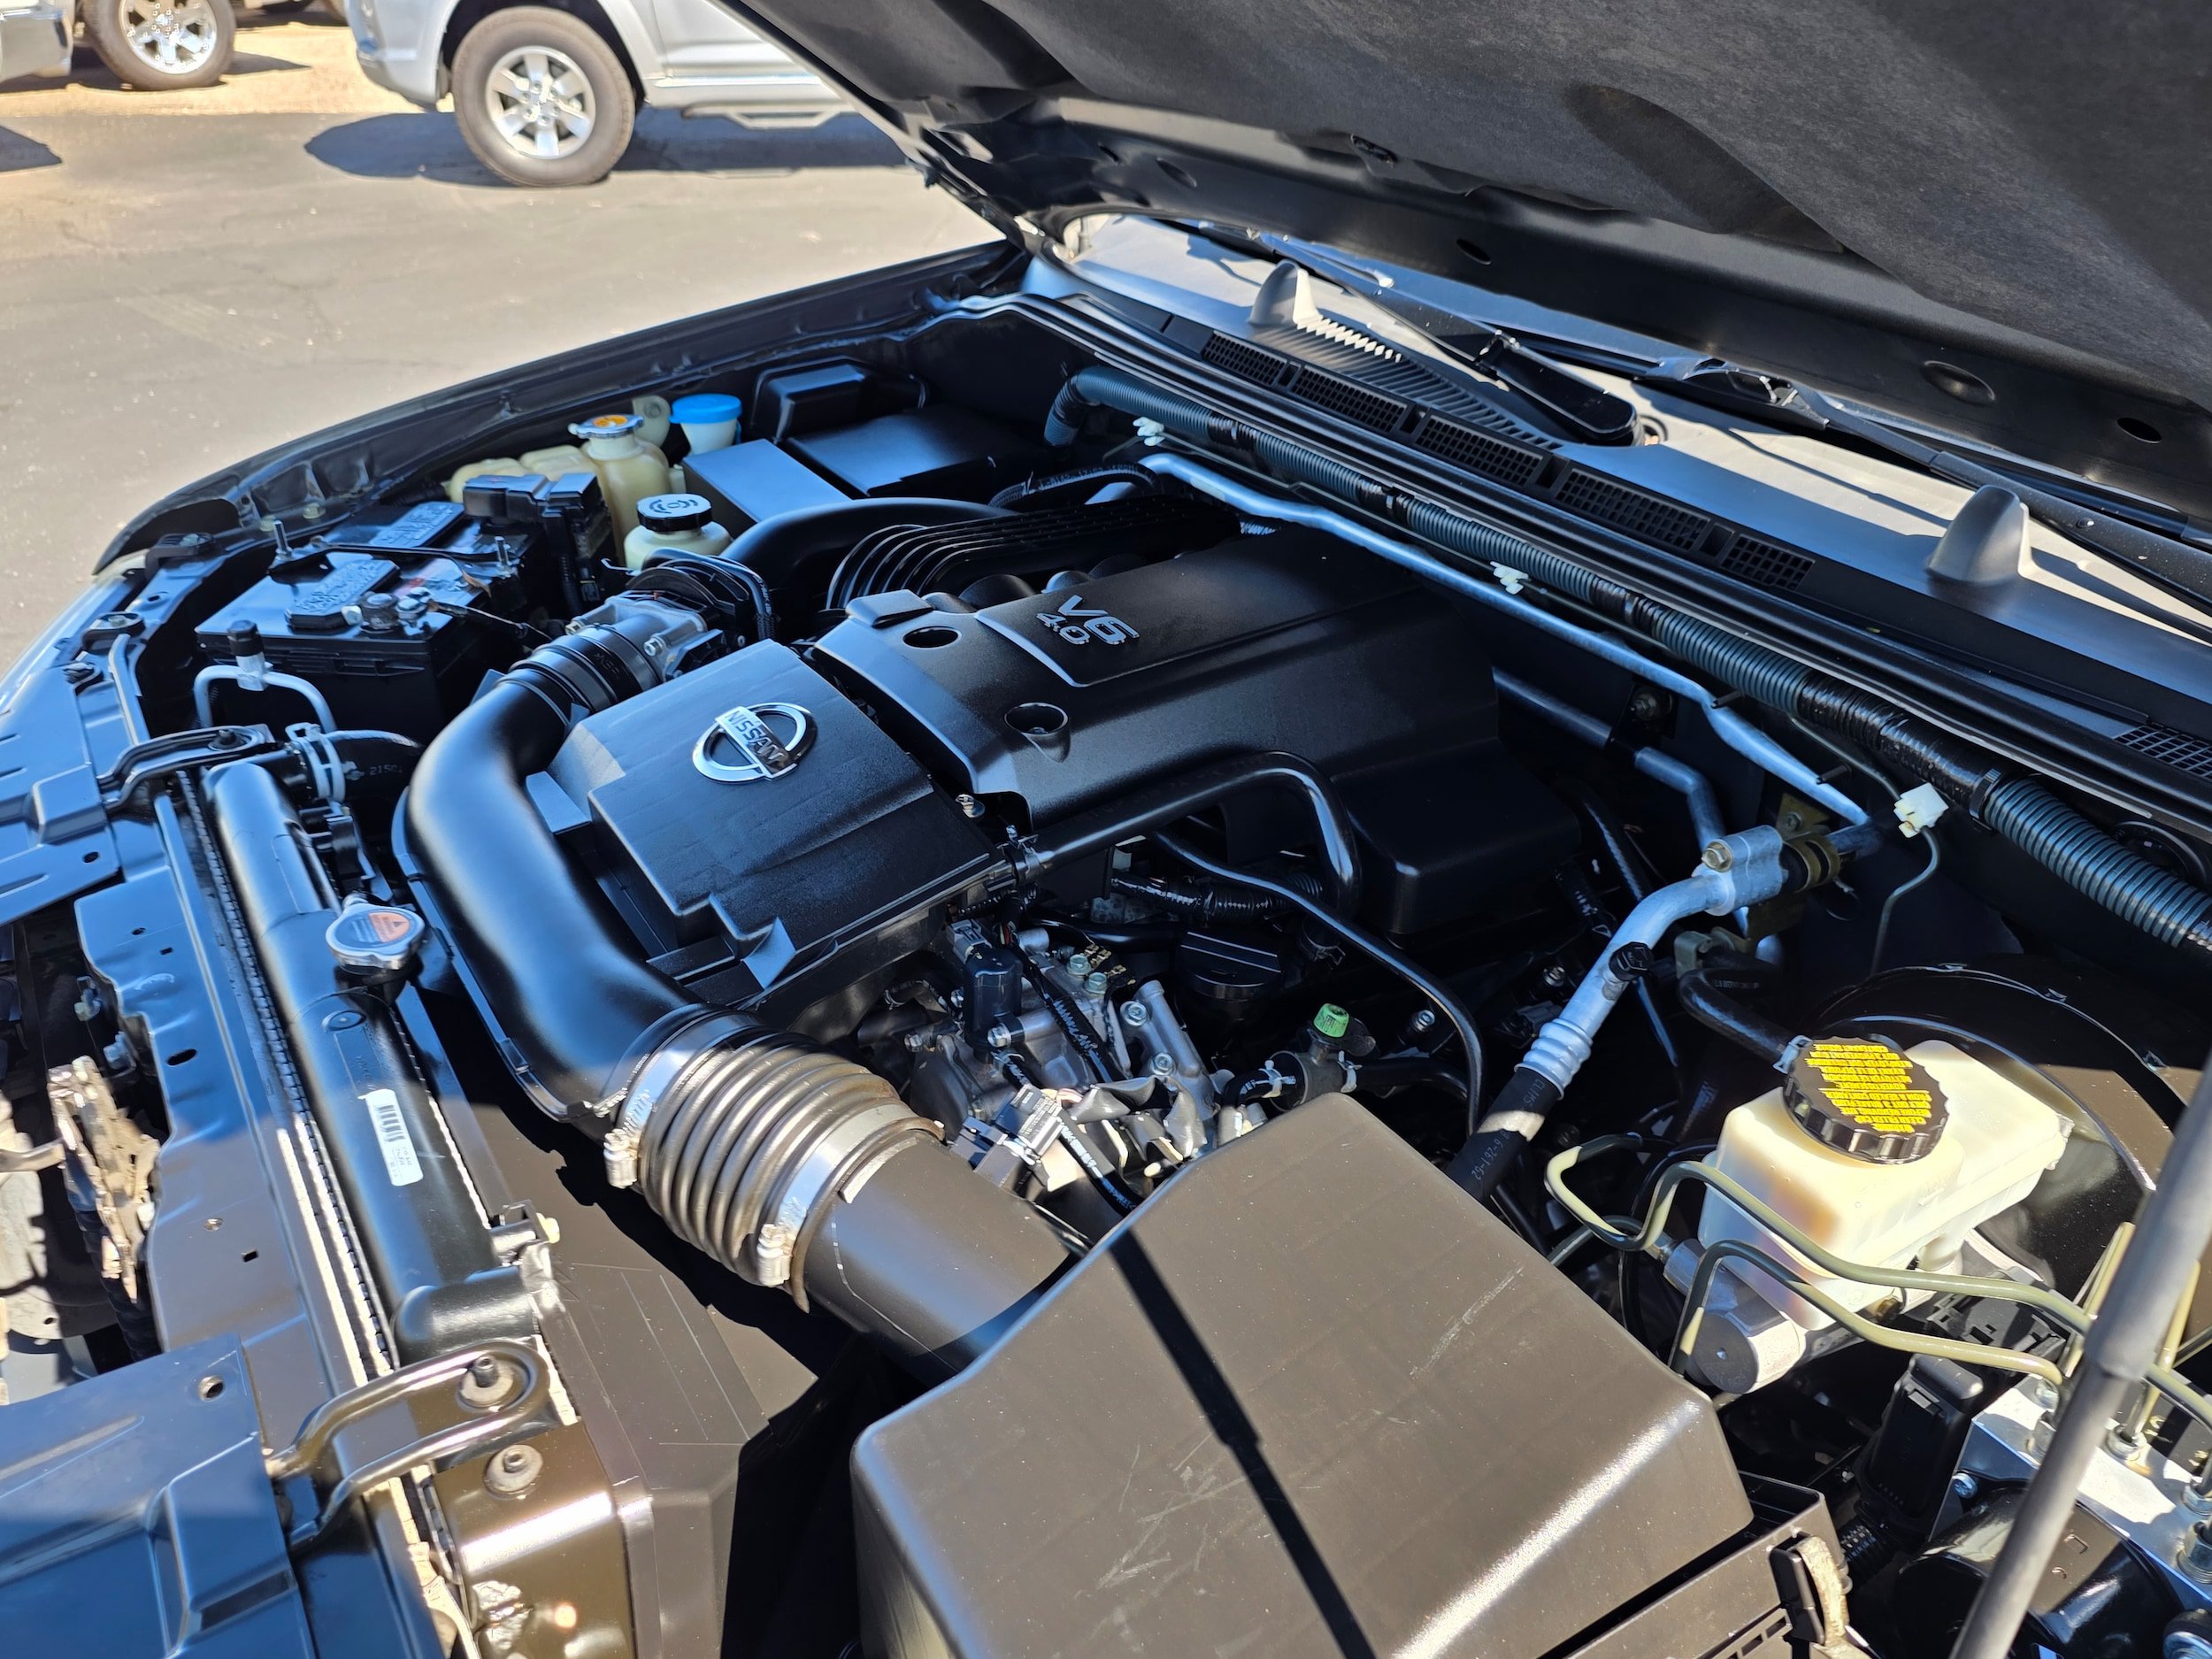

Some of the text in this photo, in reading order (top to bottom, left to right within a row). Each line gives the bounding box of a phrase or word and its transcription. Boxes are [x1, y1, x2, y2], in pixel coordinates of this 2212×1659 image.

[1036, 612, 1091, 646] 4.0
[1057, 595, 1140, 645] V6
[725, 710, 786, 764] NISSAN
